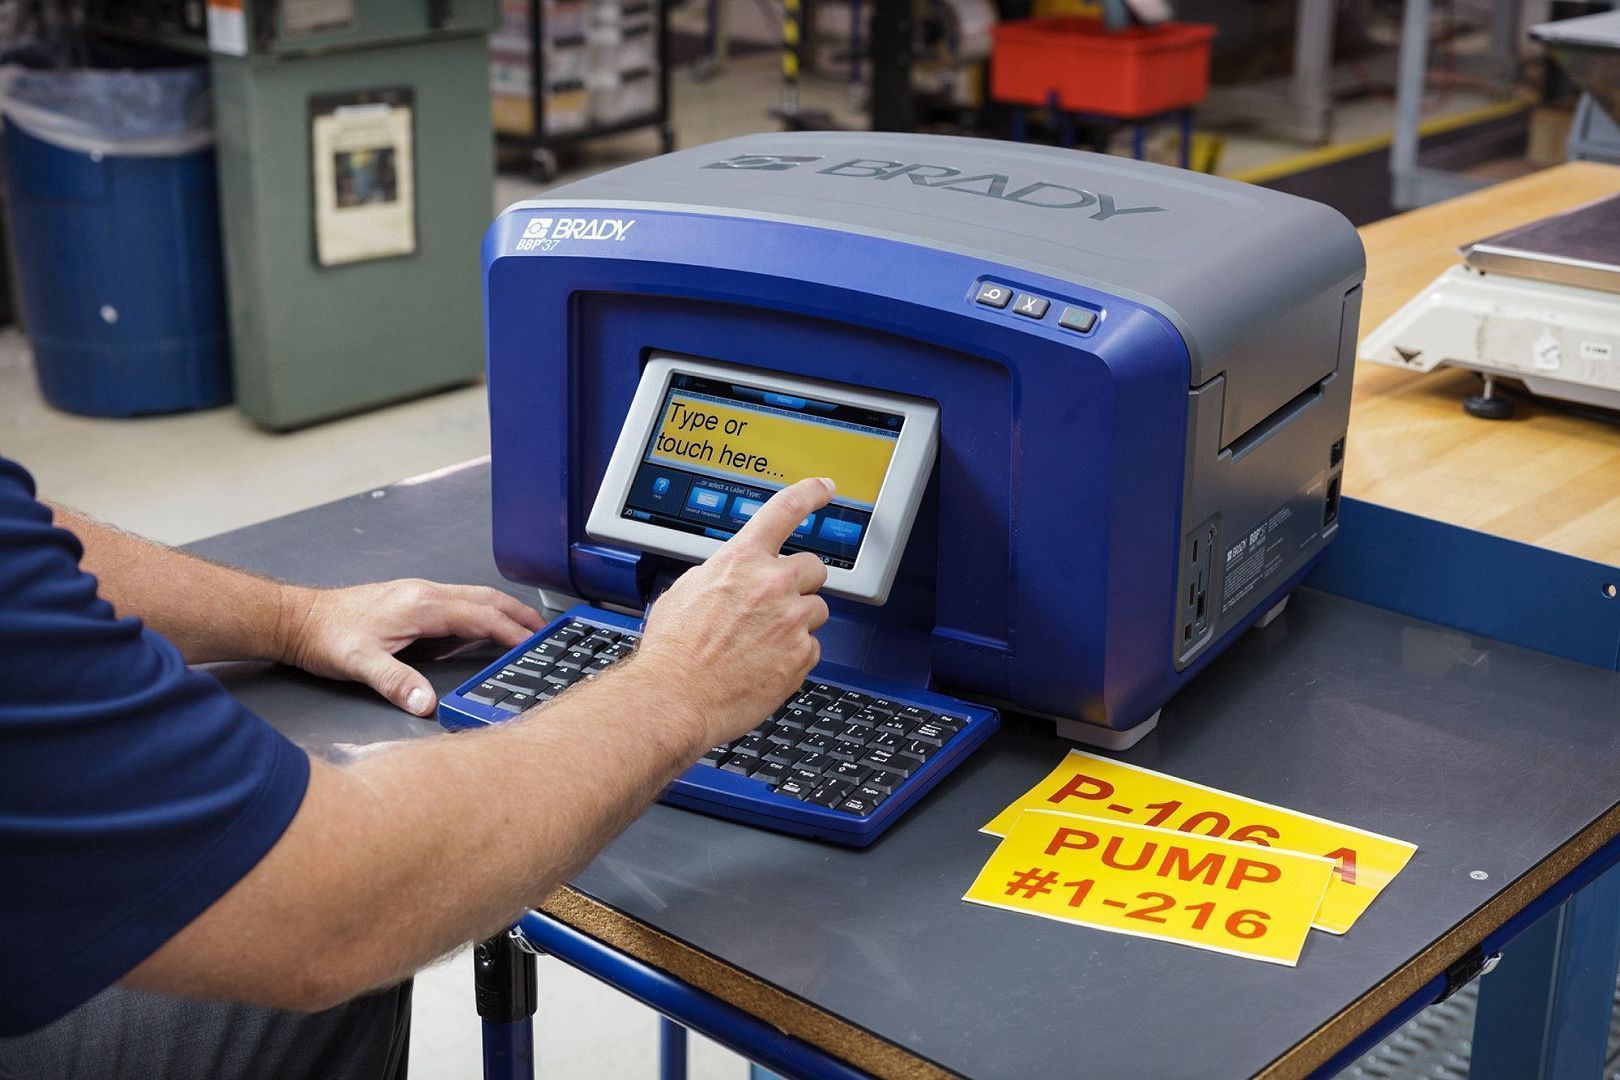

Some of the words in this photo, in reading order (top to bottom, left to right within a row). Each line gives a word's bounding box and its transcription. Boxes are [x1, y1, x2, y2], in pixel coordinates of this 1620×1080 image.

[815, 158, 1170, 221] BRADY
[551, 218, 635, 241] BRADY
[670, 402, 718, 431] Type
[724, 420, 748, 436] or
[656, 432, 714, 462] touch
[718, 448, 784, 478] here...
[1044, 827, 1282, 890] PUMP
[1004, 867, 1272, 940] #1-216
